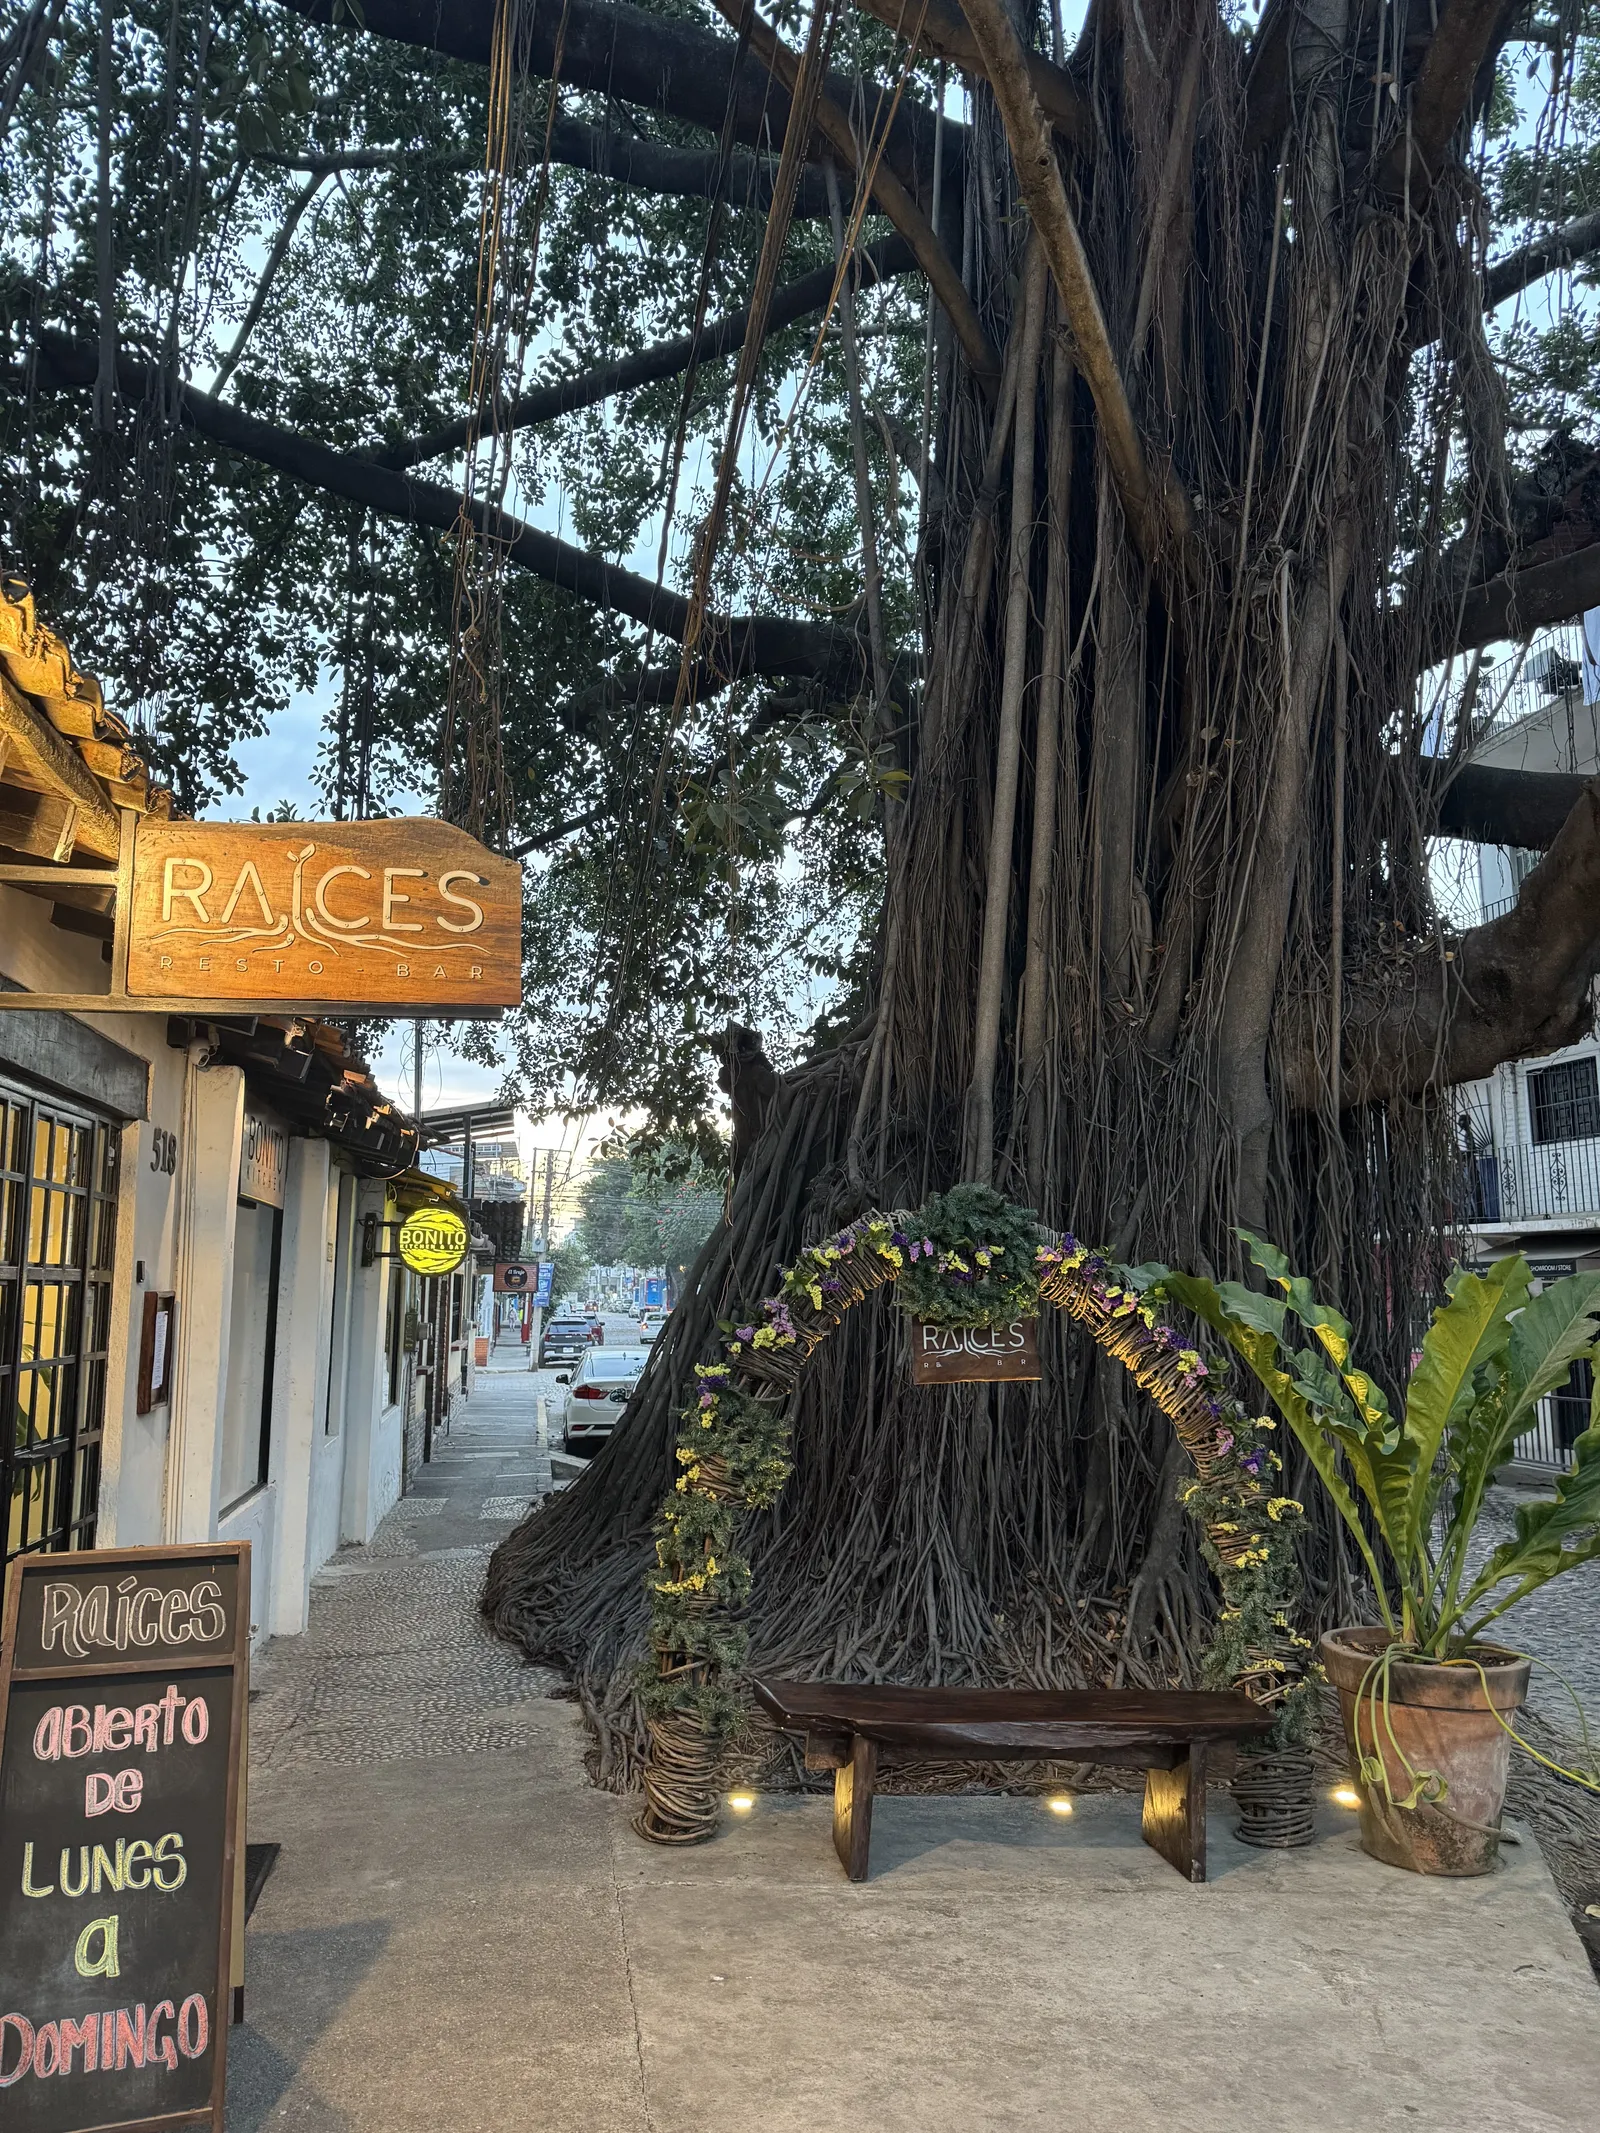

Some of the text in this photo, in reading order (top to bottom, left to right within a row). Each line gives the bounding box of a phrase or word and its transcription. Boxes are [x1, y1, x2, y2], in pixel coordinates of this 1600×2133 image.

[397, 962, 485, 980] BAR
[150, 1127, 177, 1177] 518
[248, 1115, 284, 1175] BONITO
[399, 1230, 467, 1246] BONITO
